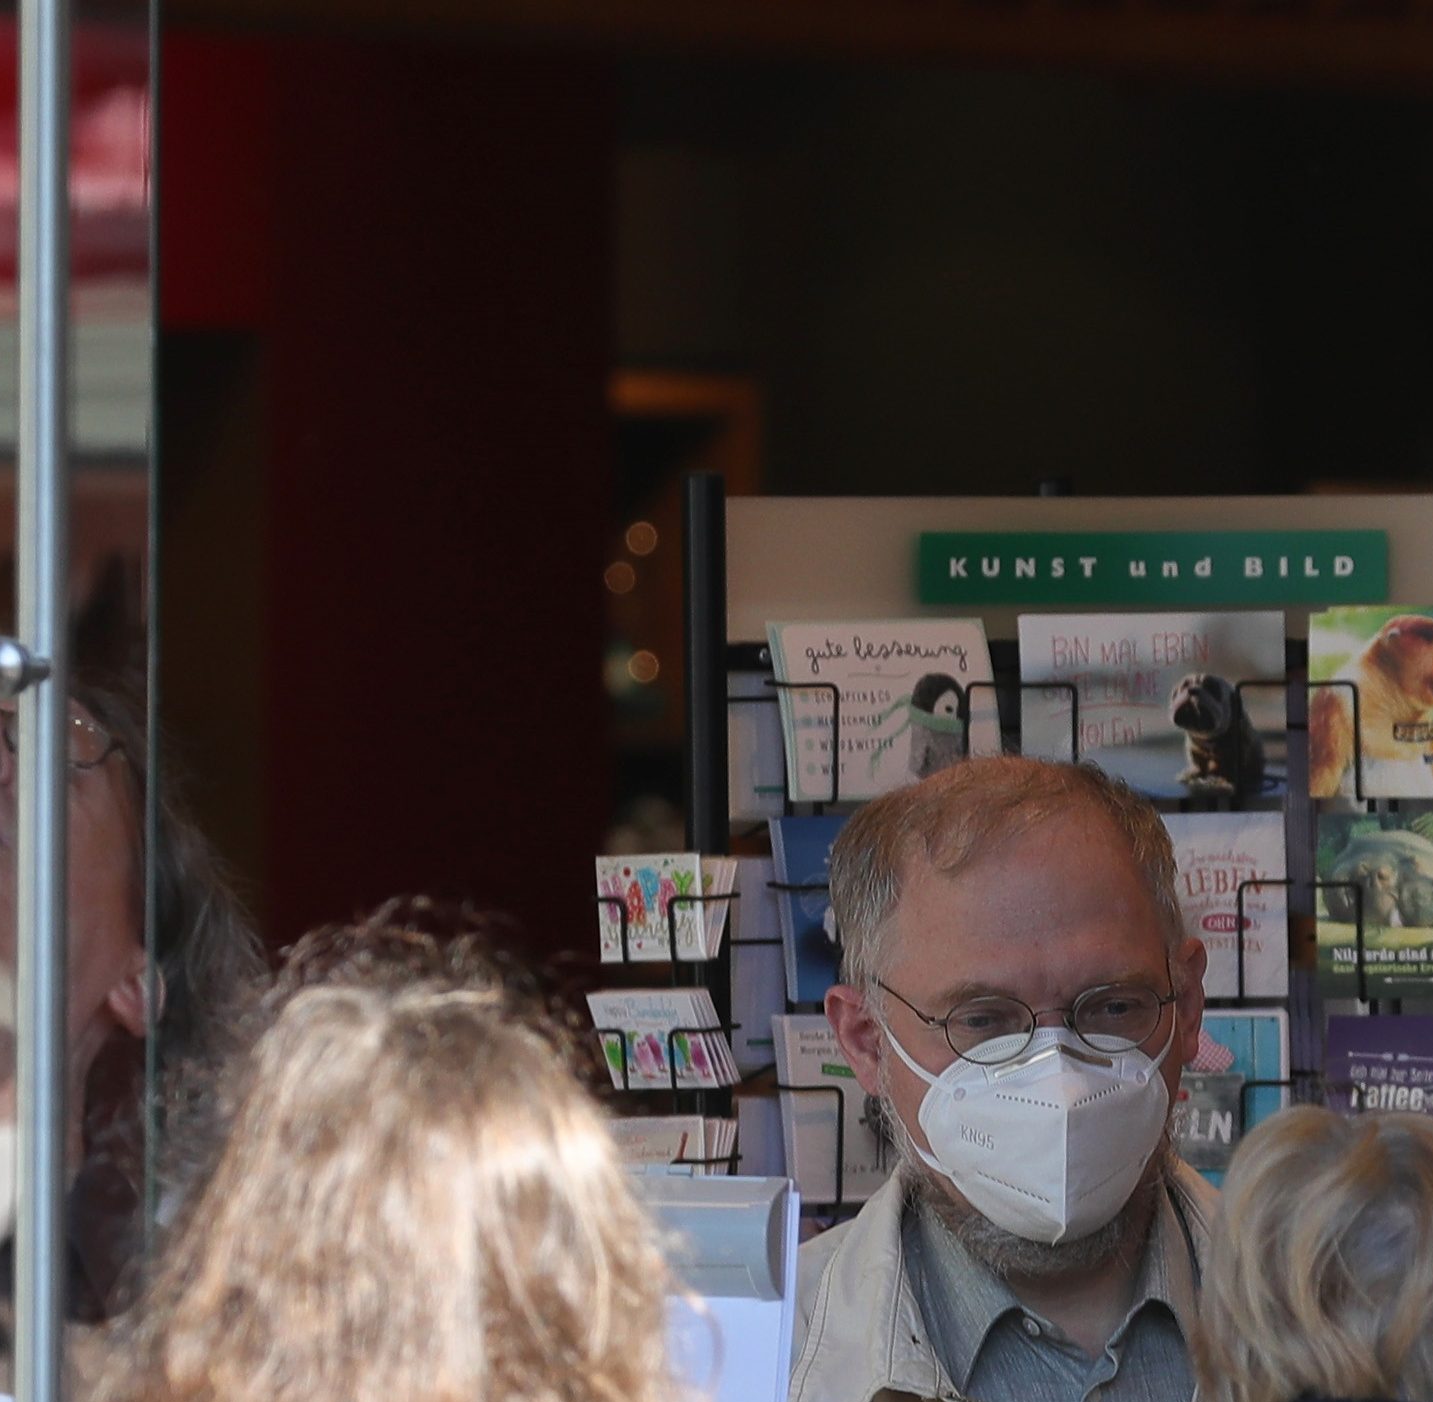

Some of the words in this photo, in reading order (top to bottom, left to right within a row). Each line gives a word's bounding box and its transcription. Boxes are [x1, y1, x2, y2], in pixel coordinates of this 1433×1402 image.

[949, 556, 1098, 579] KUNST
[1129, 555, 1213, 578] und
[1244, 555, 1355, 577] BILD
[805, 639, 848, 674] gute
[852, 636, 969, 673] besserung
[1100, 638, 1140, 669] MAL
[1152, 632, 1210, 665] EBEN
[1182, 865, 1267, 897] LEBEN
[1398, 947, 1428, 962] sind
[1390, 1067, 1408, 1084] zur
[959, 1124, 995, 1150] KN95
